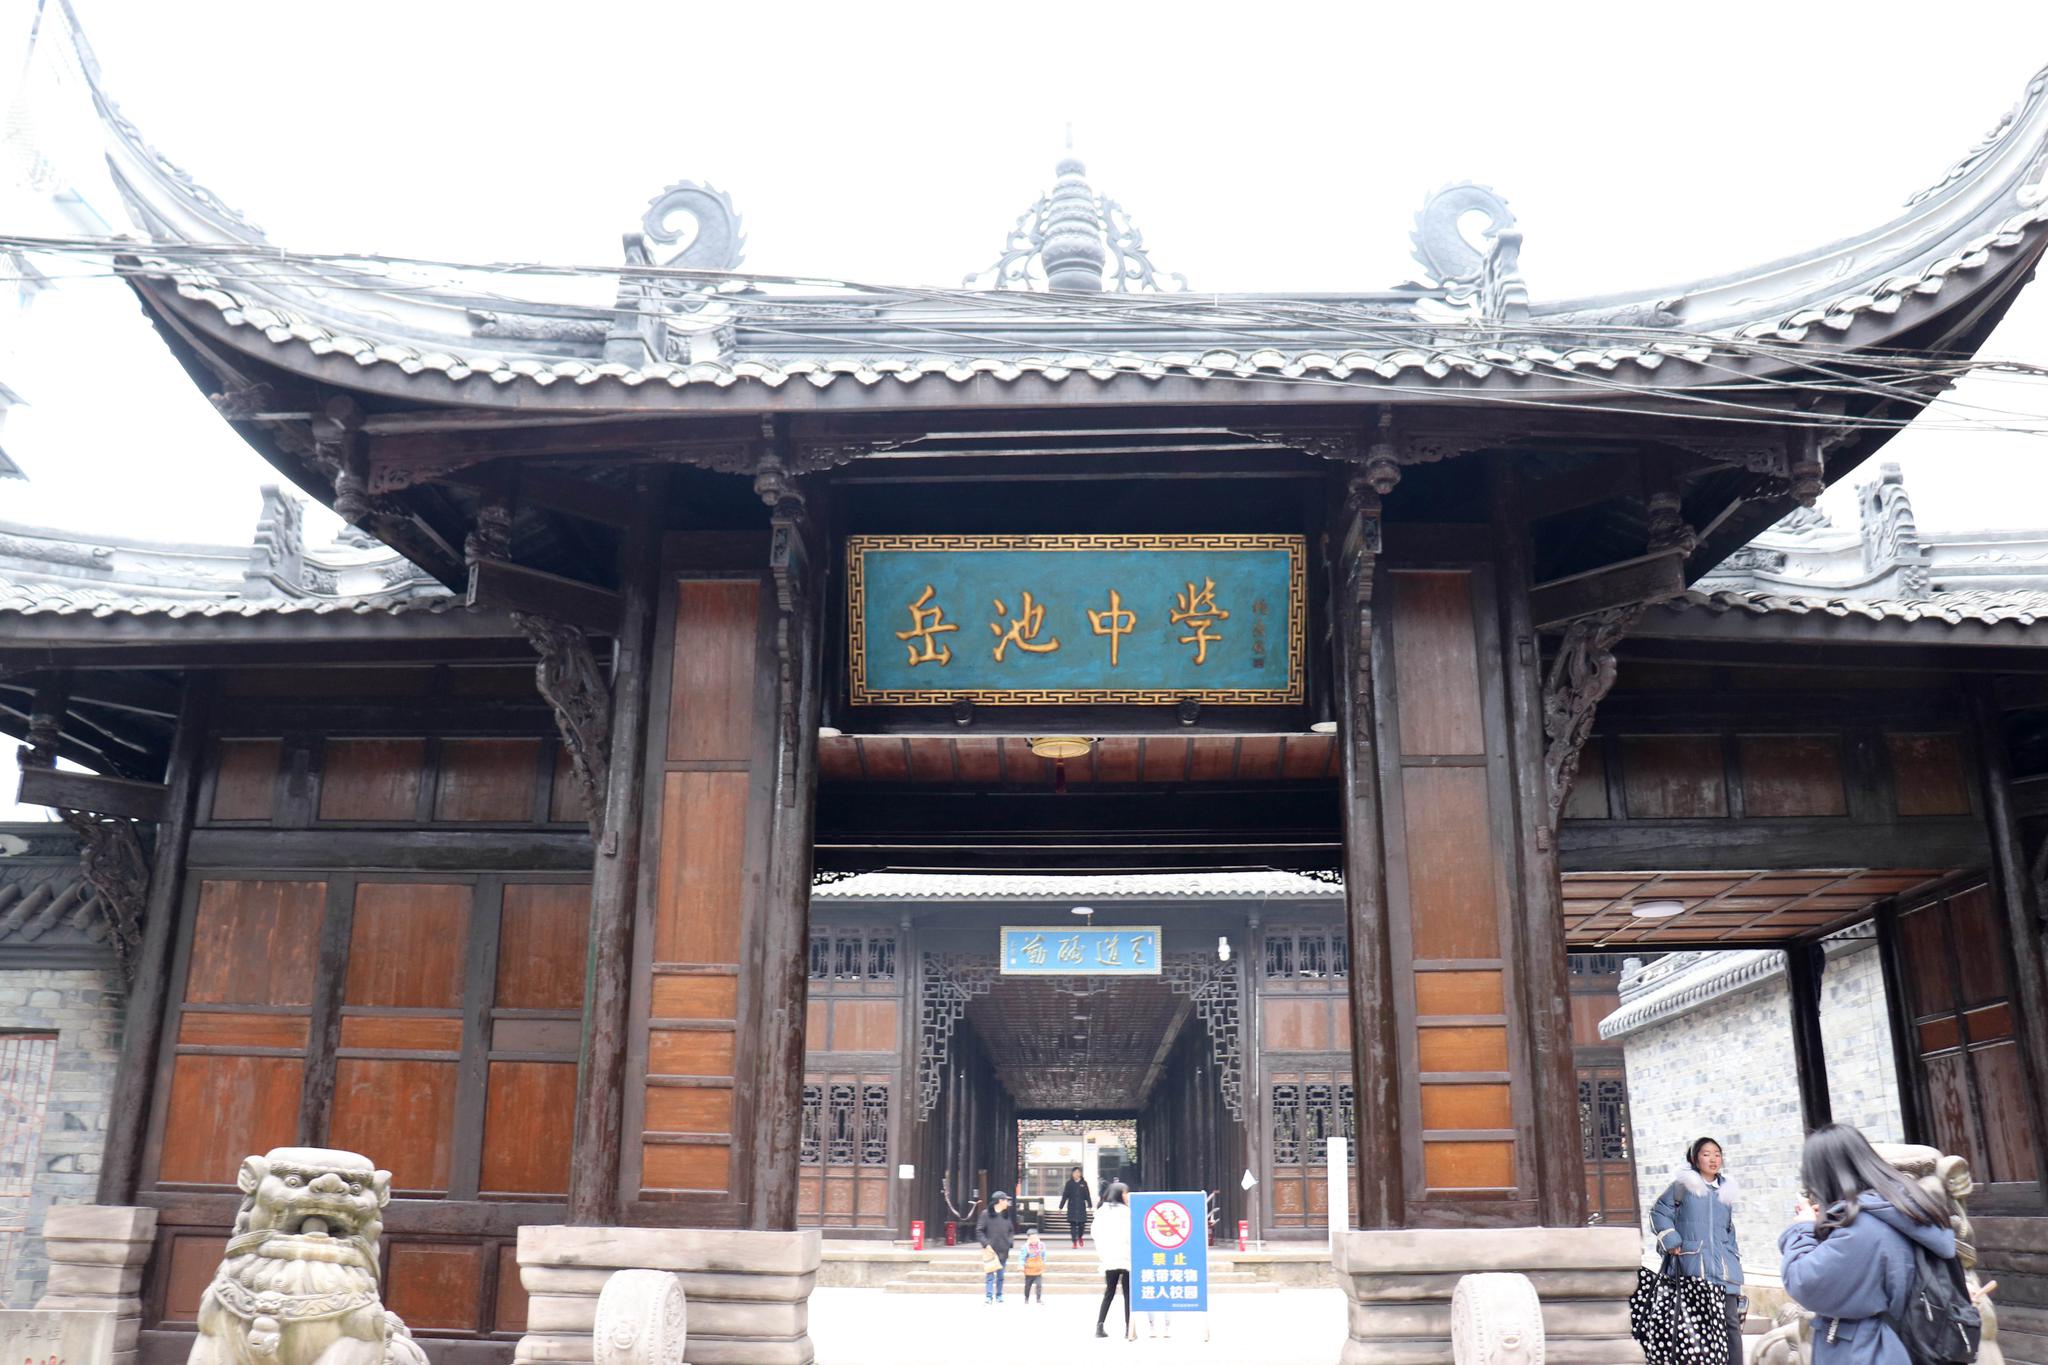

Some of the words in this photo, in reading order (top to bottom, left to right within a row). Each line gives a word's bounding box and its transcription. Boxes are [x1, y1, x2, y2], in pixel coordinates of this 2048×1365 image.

[1152, 1252, 1188, 1266] 禁止
[1141, 1269, 1198, 1283] 携带宠物
[1141, 1285, 1198, 1300] 进入校园
